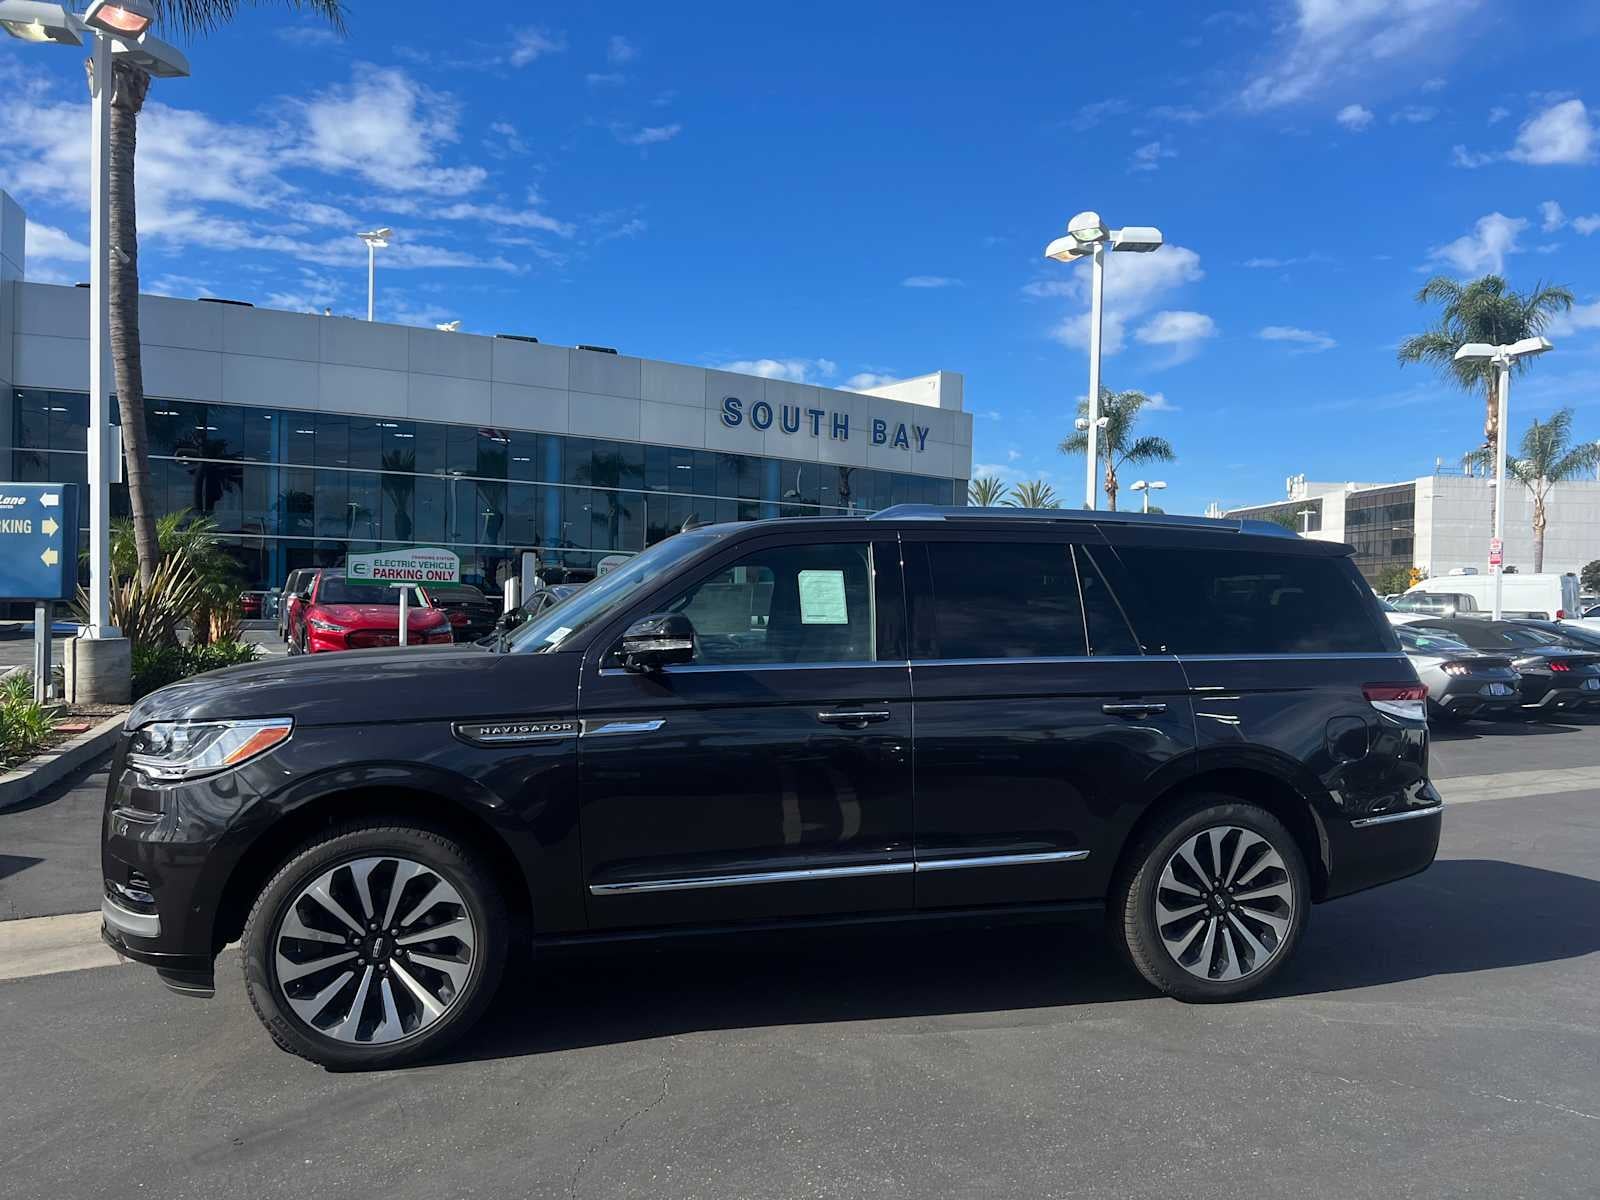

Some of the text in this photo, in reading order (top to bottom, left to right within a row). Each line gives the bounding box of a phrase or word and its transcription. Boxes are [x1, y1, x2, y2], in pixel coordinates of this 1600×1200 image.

[722, 396, 930, 451] SOUTH BAY
[0, 519, 32, 534] KING
[374, 559, 455, 570] ELECTRIC VEHICLE
[373, 568, 455, 581] PARKING ONLY
[480, 723, 572, 735] NAVIGATOR
